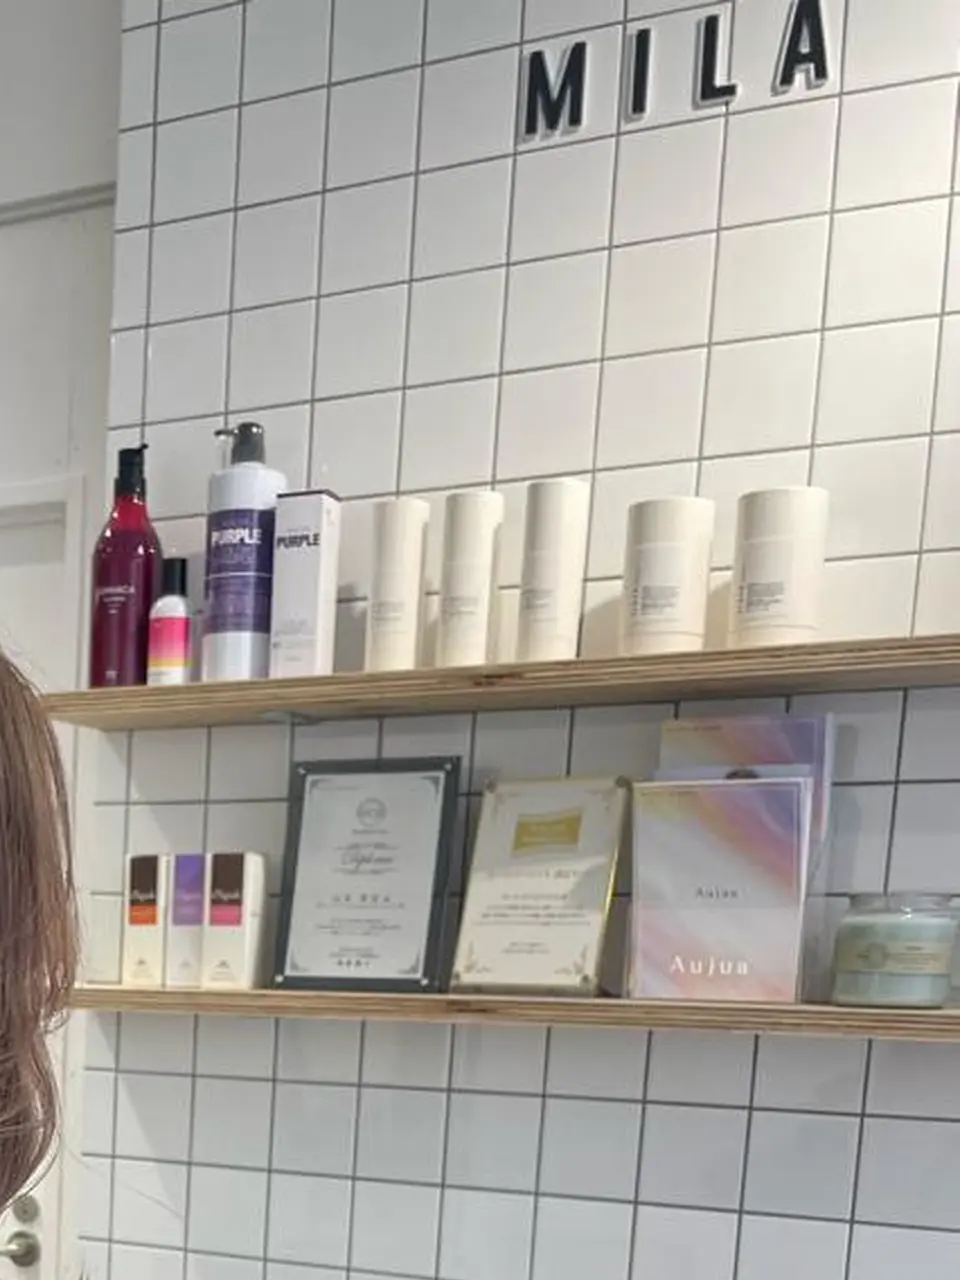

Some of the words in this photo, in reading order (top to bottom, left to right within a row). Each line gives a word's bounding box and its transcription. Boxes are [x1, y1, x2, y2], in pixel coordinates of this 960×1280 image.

[520, 0, 829, 140] MILA
[211, 528, 262, 546] PURPLE
[277, 533, 320, 549] PURPLE
